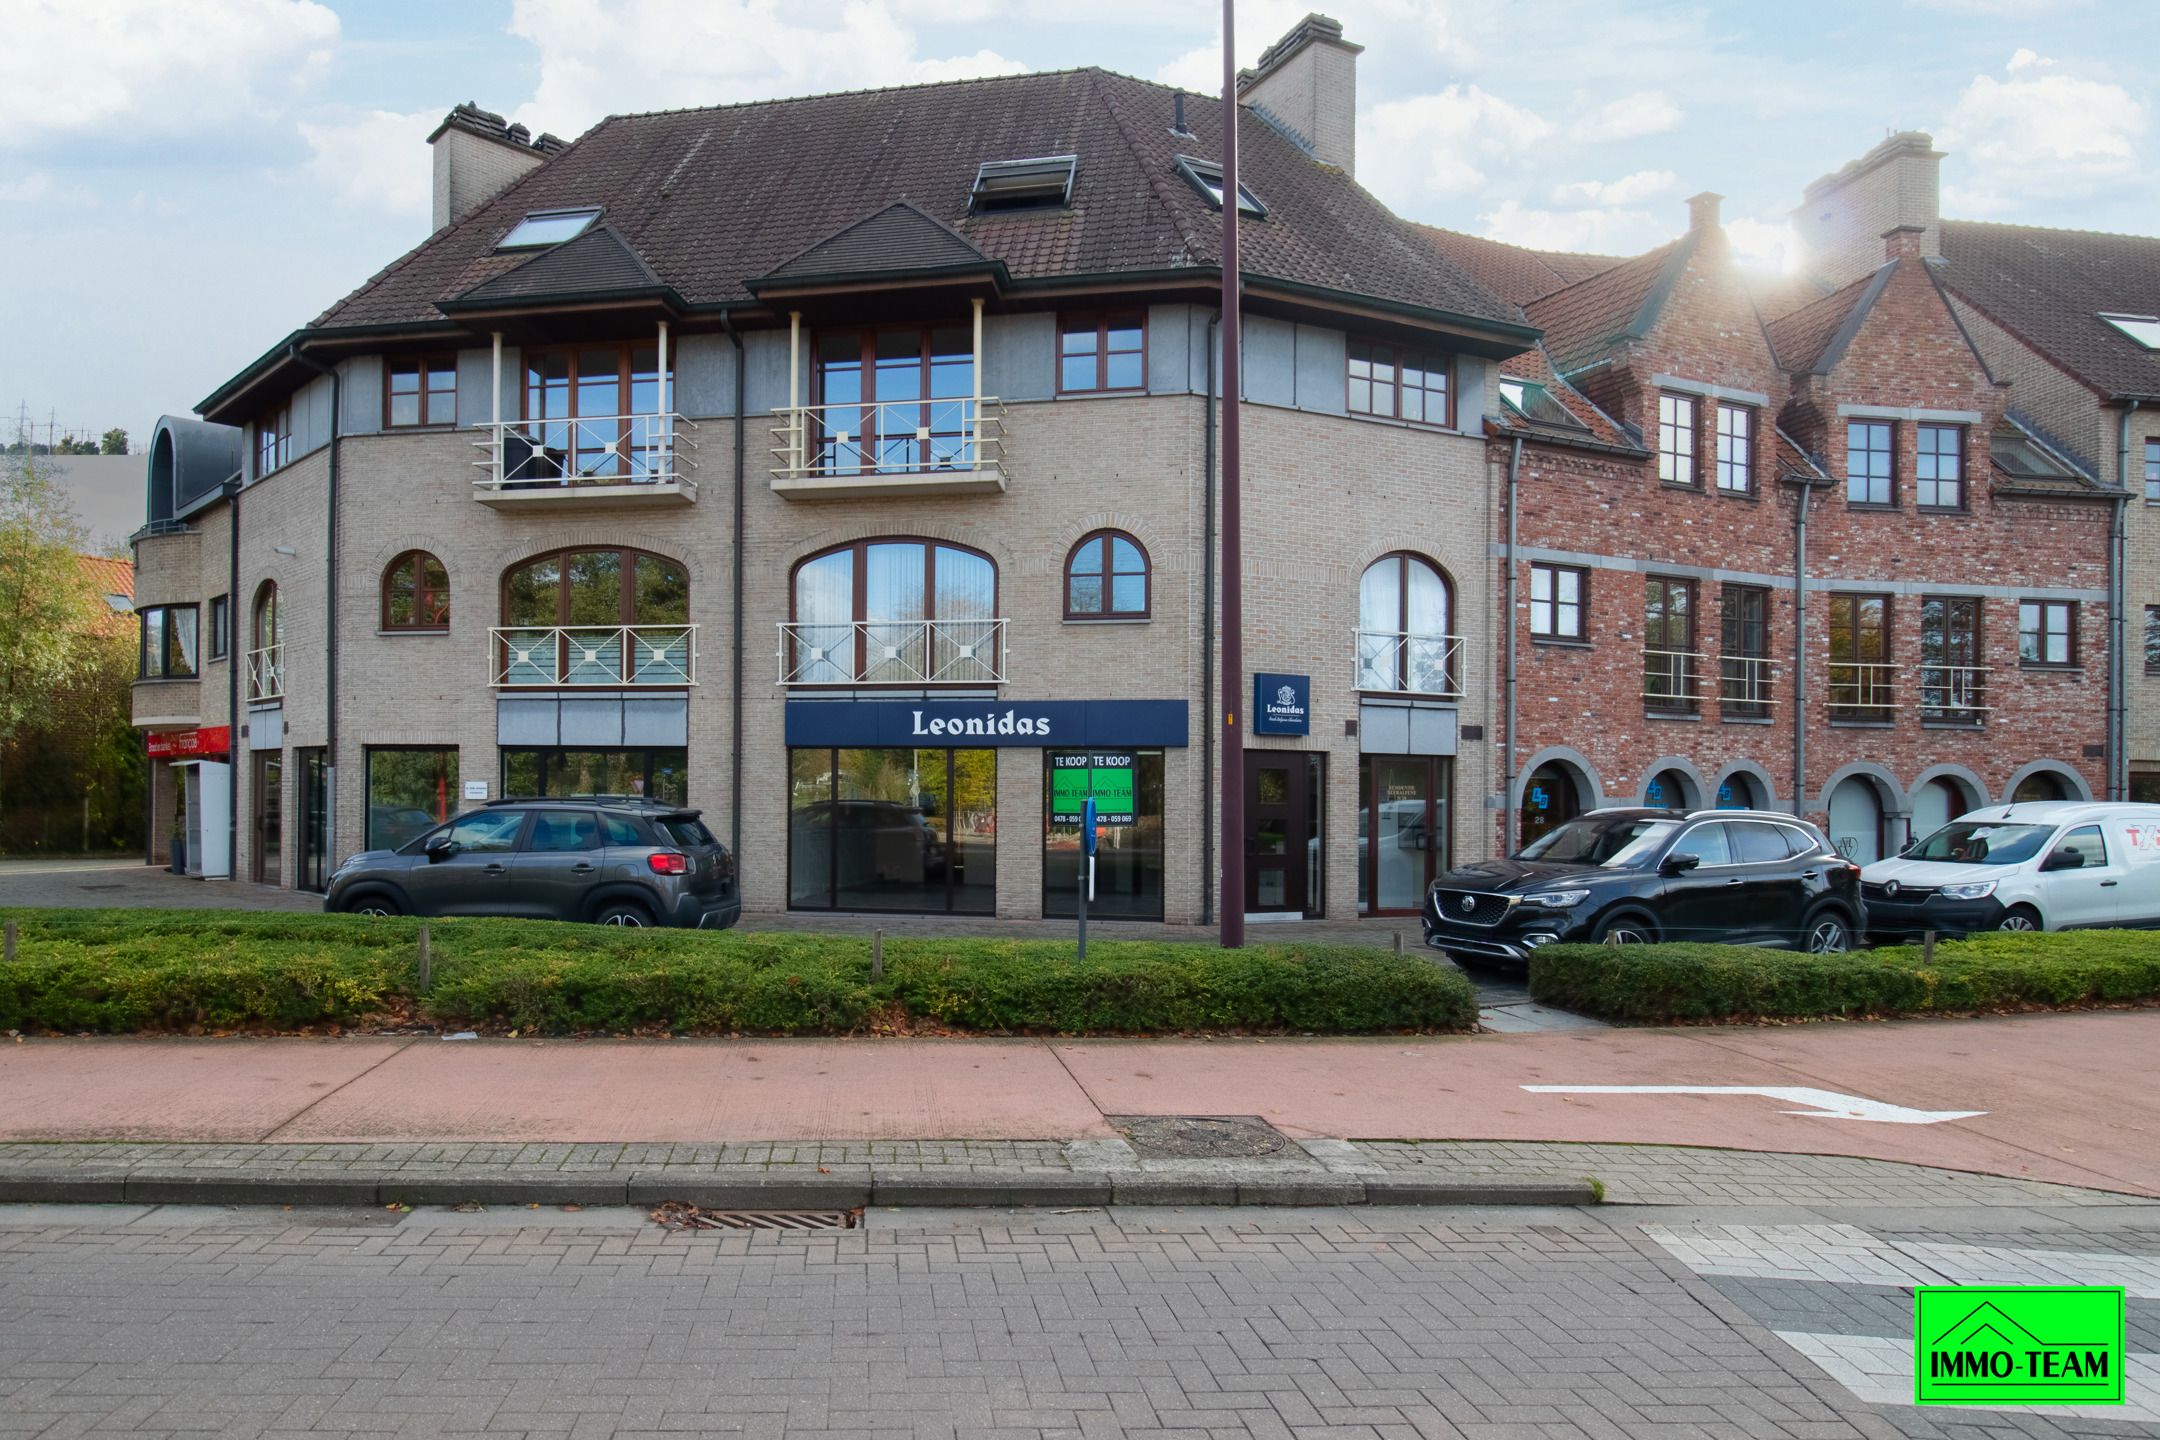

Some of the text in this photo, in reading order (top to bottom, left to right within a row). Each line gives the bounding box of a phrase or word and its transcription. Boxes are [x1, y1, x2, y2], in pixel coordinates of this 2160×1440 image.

[1267, 704, 1304, 714] Leonidas
[912, 709, 1050, 735] Leonidas
[1055, 757, 1087, 766] TE KOOP
[1093, 756, 1131, 766] TE KOOP
[2126, 824, 2160, 850] TX
